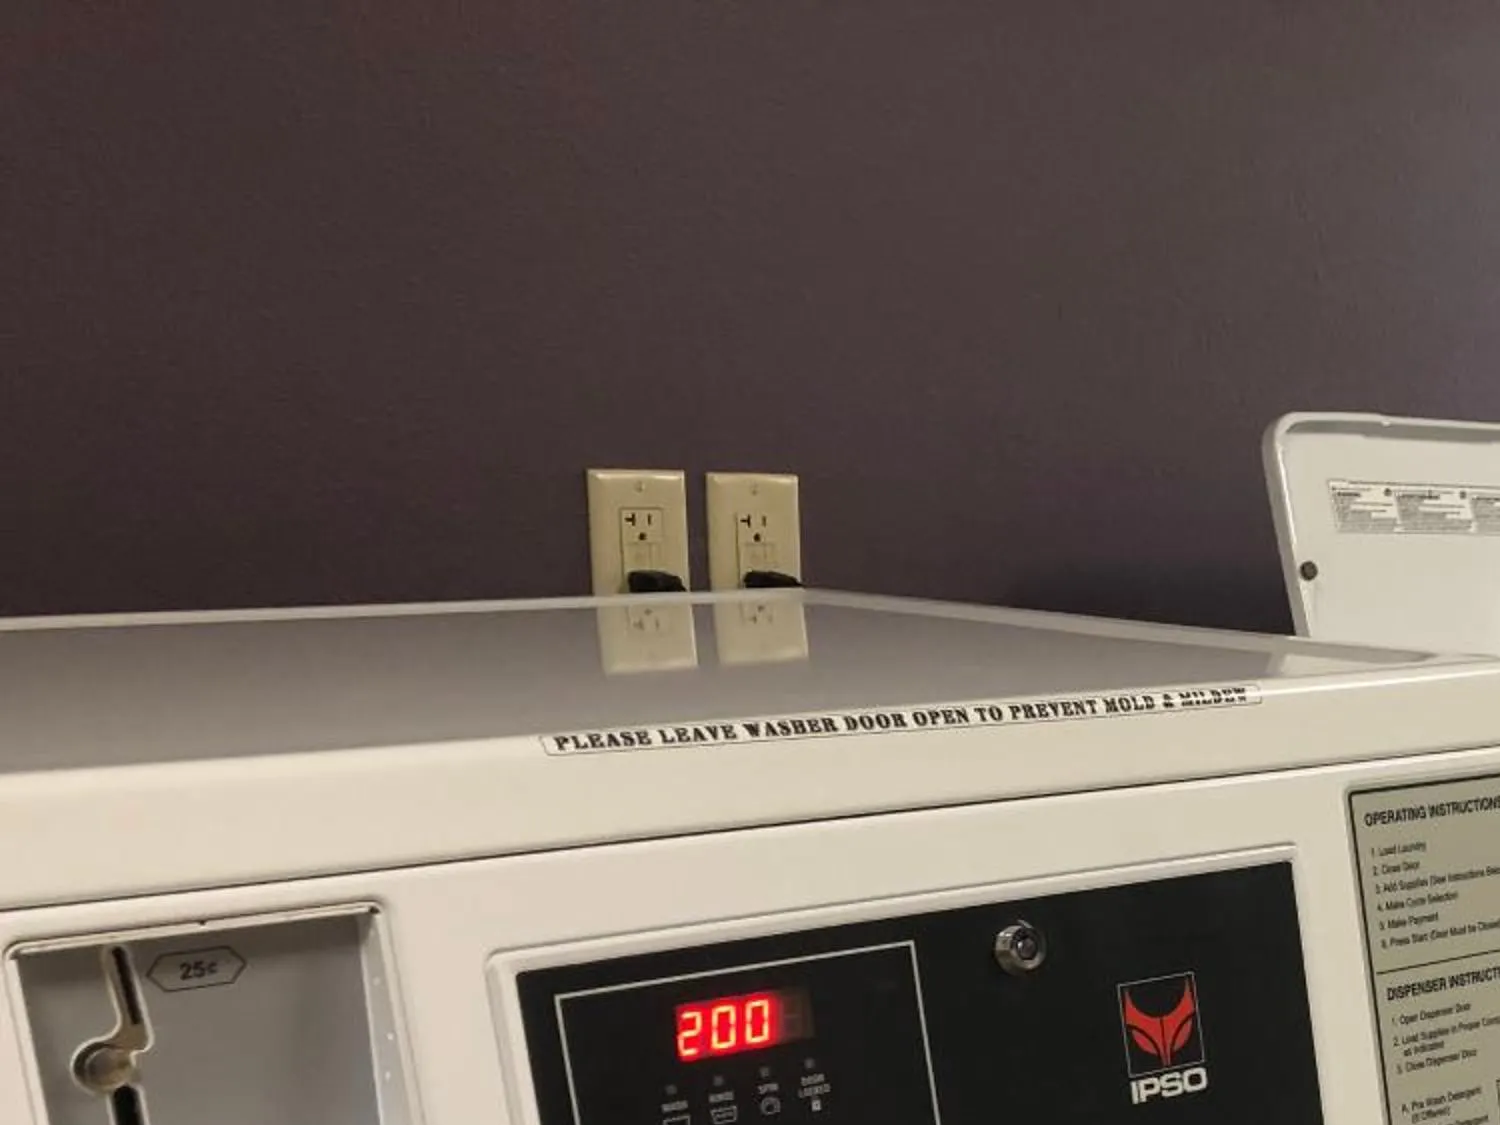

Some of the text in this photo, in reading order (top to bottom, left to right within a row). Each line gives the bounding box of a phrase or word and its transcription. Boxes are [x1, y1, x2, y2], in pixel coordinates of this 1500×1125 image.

[553, 730, 651, 751] PLEASE
[658, 723, 736, 744] LEAVE
[743, 716, 838, 738] WASHER
[845, 711, 906, 732] DOOR
[913, 708, 969, 728] OPEN
[977, 706, 1003, 723] TO
[1010, 698, 1097, 721] PREVENT
[1105, 693, 1156, 713] MOLD
[1178, 686, 1247, 707] MILDEW
[1364, 805, 1427, 826] OPERATING
[1387, 977, 1447, 1000] DISPENSER
[677, 998, 772, 1058] 200
[1130, 1067, 1208, 1104] IPSO
